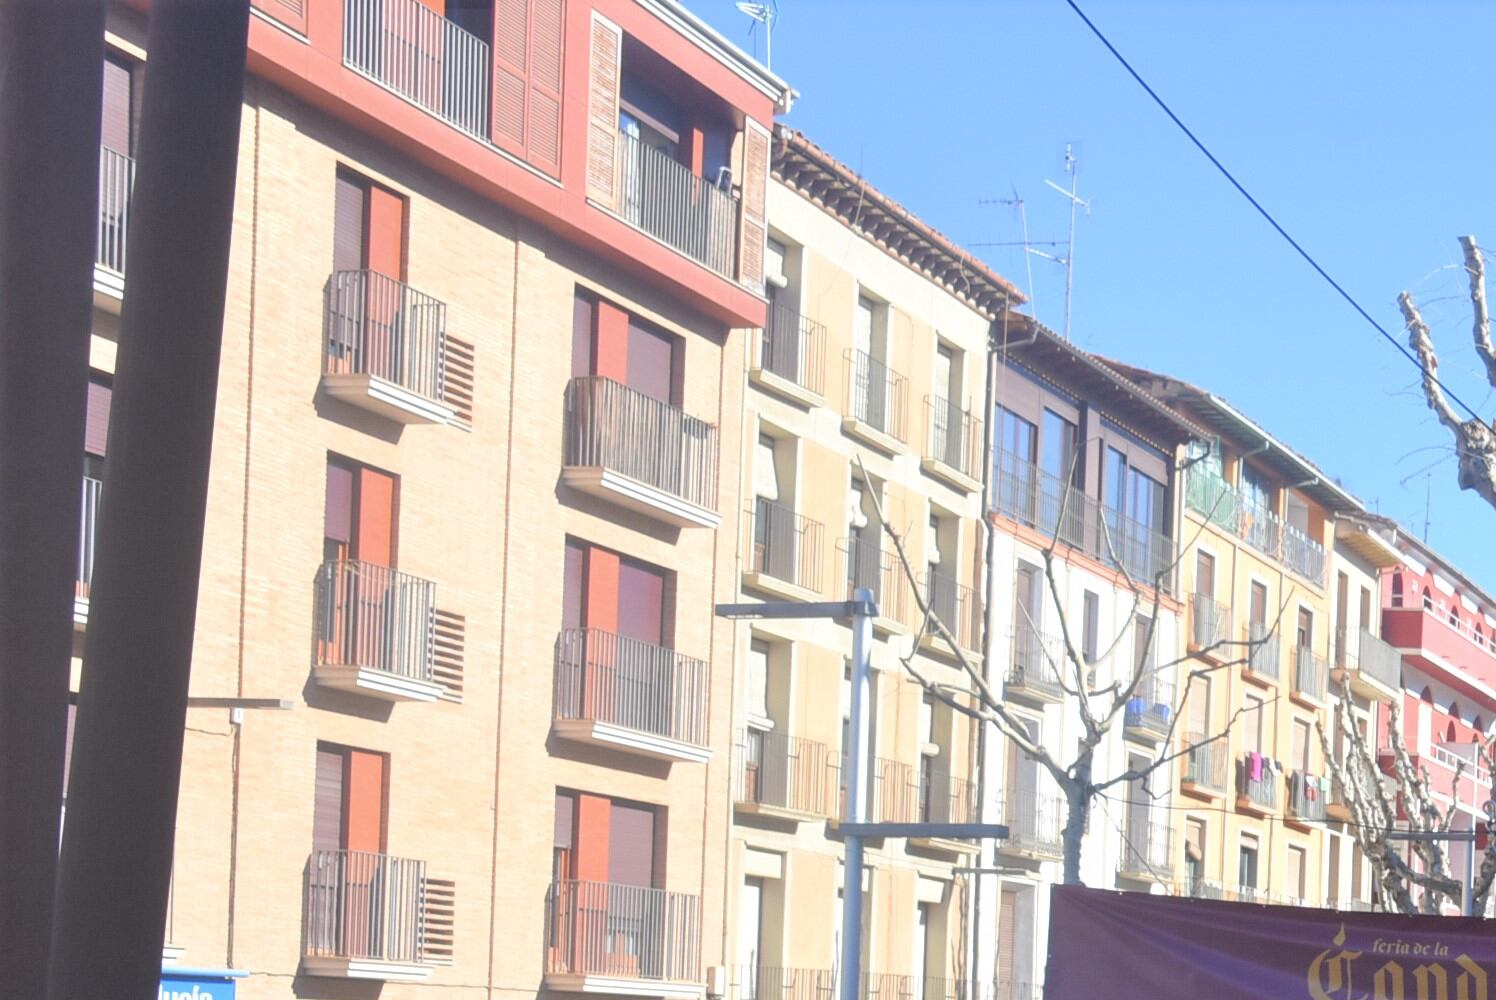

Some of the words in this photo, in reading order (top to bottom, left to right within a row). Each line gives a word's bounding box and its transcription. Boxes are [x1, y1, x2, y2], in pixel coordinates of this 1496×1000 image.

[1372, 938, 1410, 954] feria
[1413, 942, 1431, 955] de
[1434, 942, 1449, 956] la
